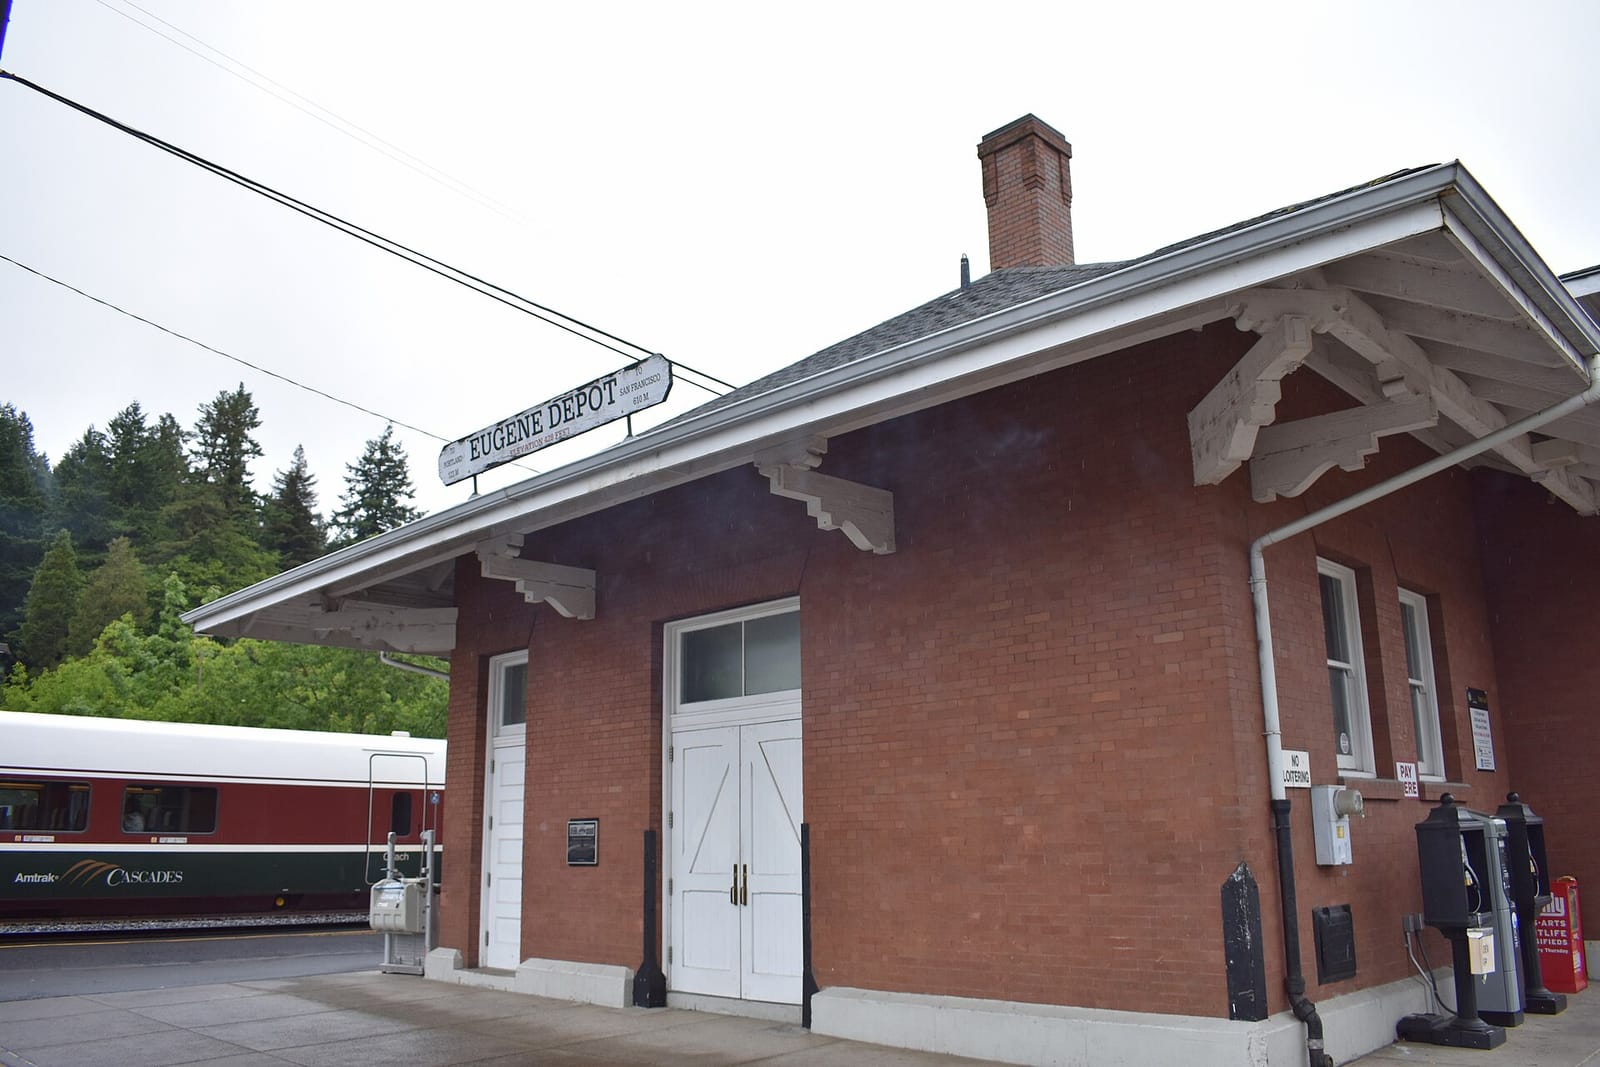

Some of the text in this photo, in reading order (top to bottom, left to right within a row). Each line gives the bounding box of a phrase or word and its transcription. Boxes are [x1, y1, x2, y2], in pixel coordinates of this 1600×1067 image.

[635, 366, 643, 376] TO
[619, 372, 661, 397] SAN FRANCISCO
[632, 394, 643, 405] 610
[470, 378, 617, 461] EUGENE DEPOT
[510, 437, 544, 457] ELEVATION
[554, 427, 570, 440] FEET
[1291, 755, 1300, 767] NO
[1283, 770, 1310, 783] LOITERING
[1400, 765, 1413, 778] PAY
[1404, 781, 1417, 794] ERE
[383, 852, 409, 861] Cach
[107, 868, 183, 887] CASCADES
